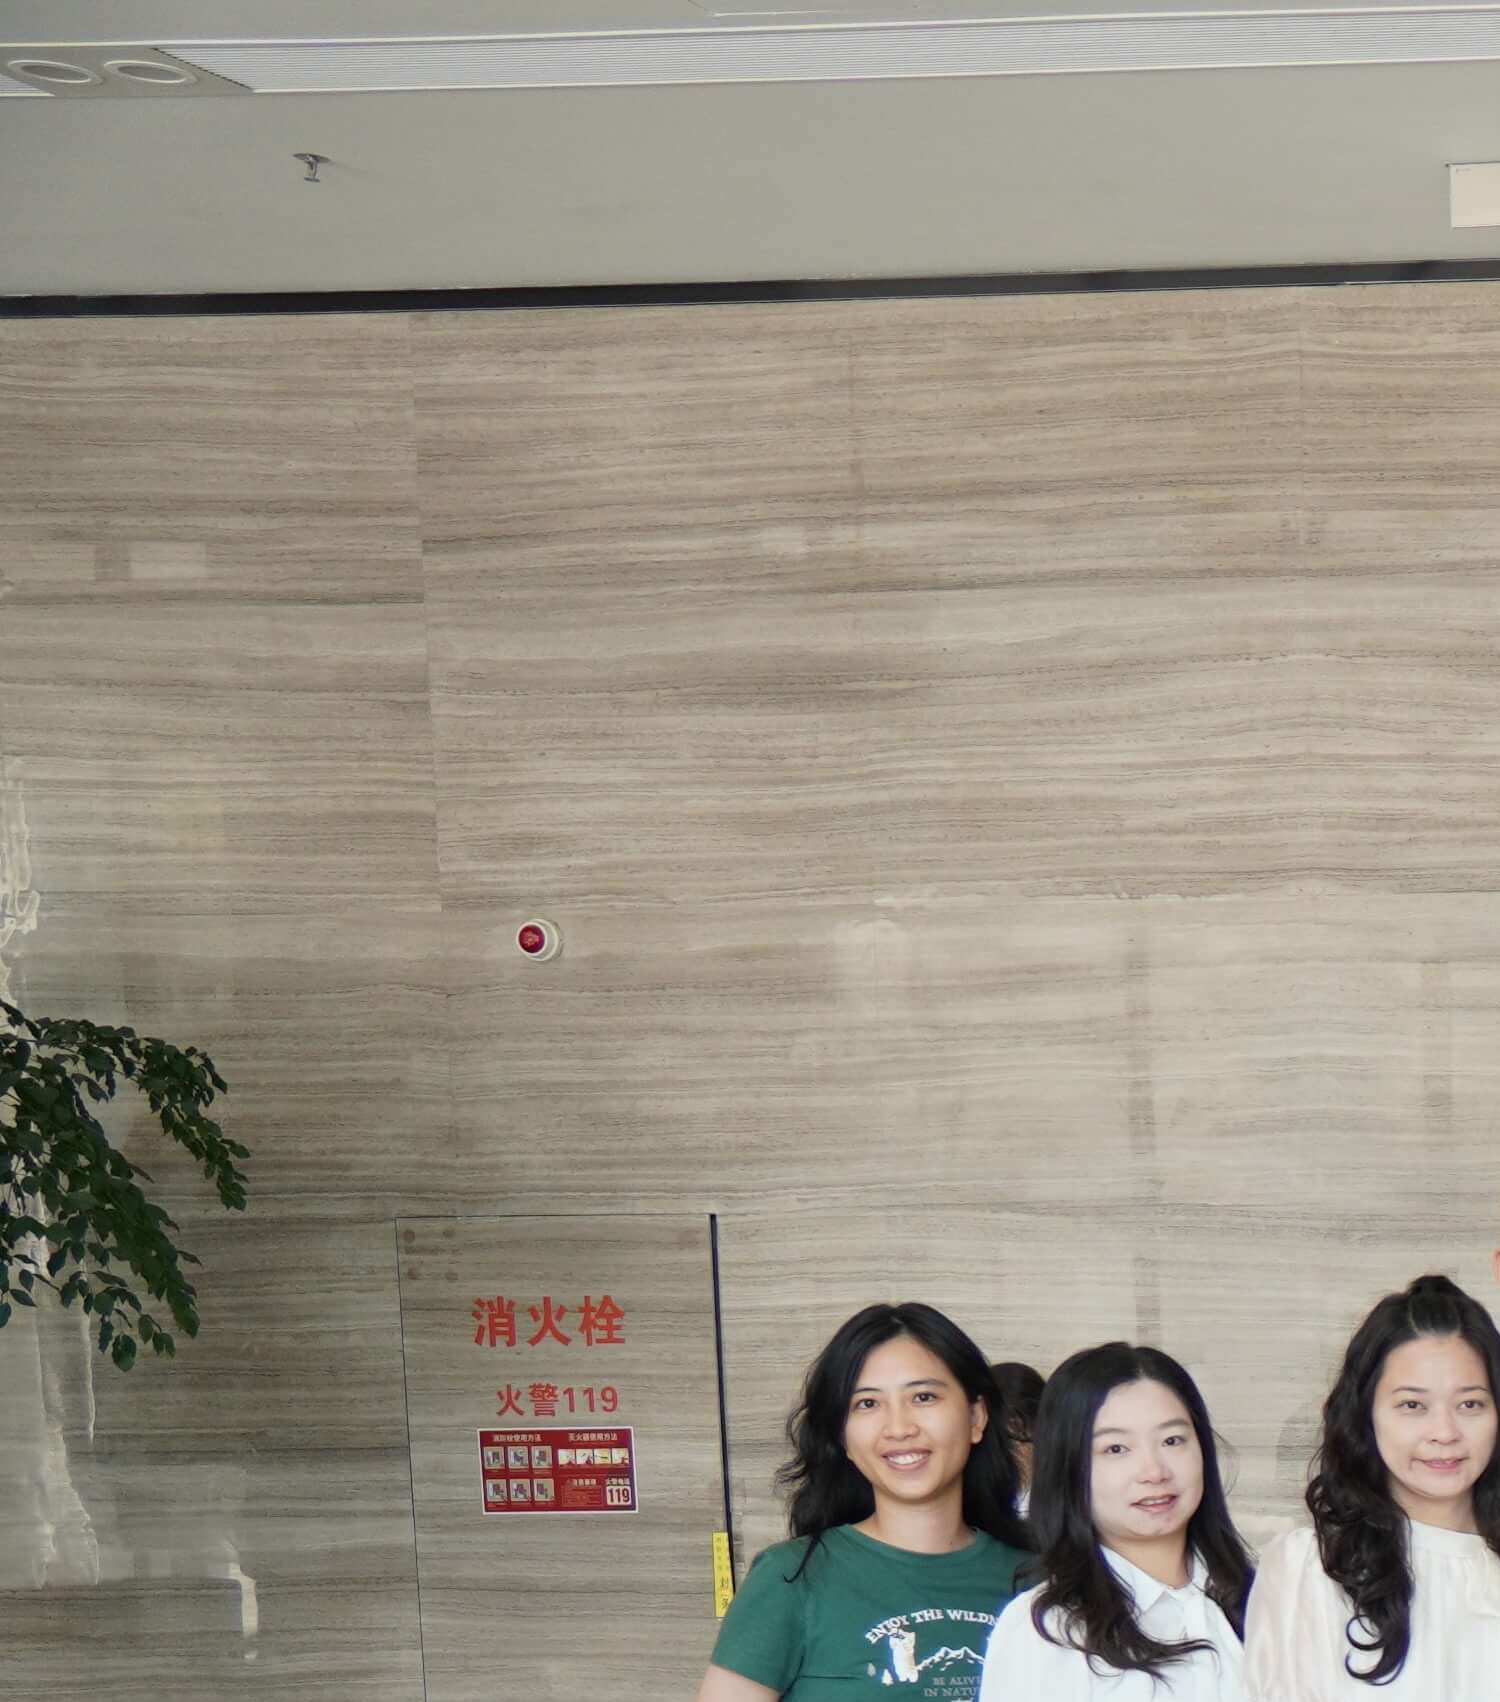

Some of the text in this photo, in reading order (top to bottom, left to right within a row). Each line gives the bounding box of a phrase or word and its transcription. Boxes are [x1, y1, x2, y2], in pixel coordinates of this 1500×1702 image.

[471, 1295, 627, 1347] 消火栓
[495, 1383, 619, 1418] 火警119
[607, 1487, 631, 1503] 119
[865, 1615, 910, 1644] ENJOY
[911, 1609, 944, 1623] THE
